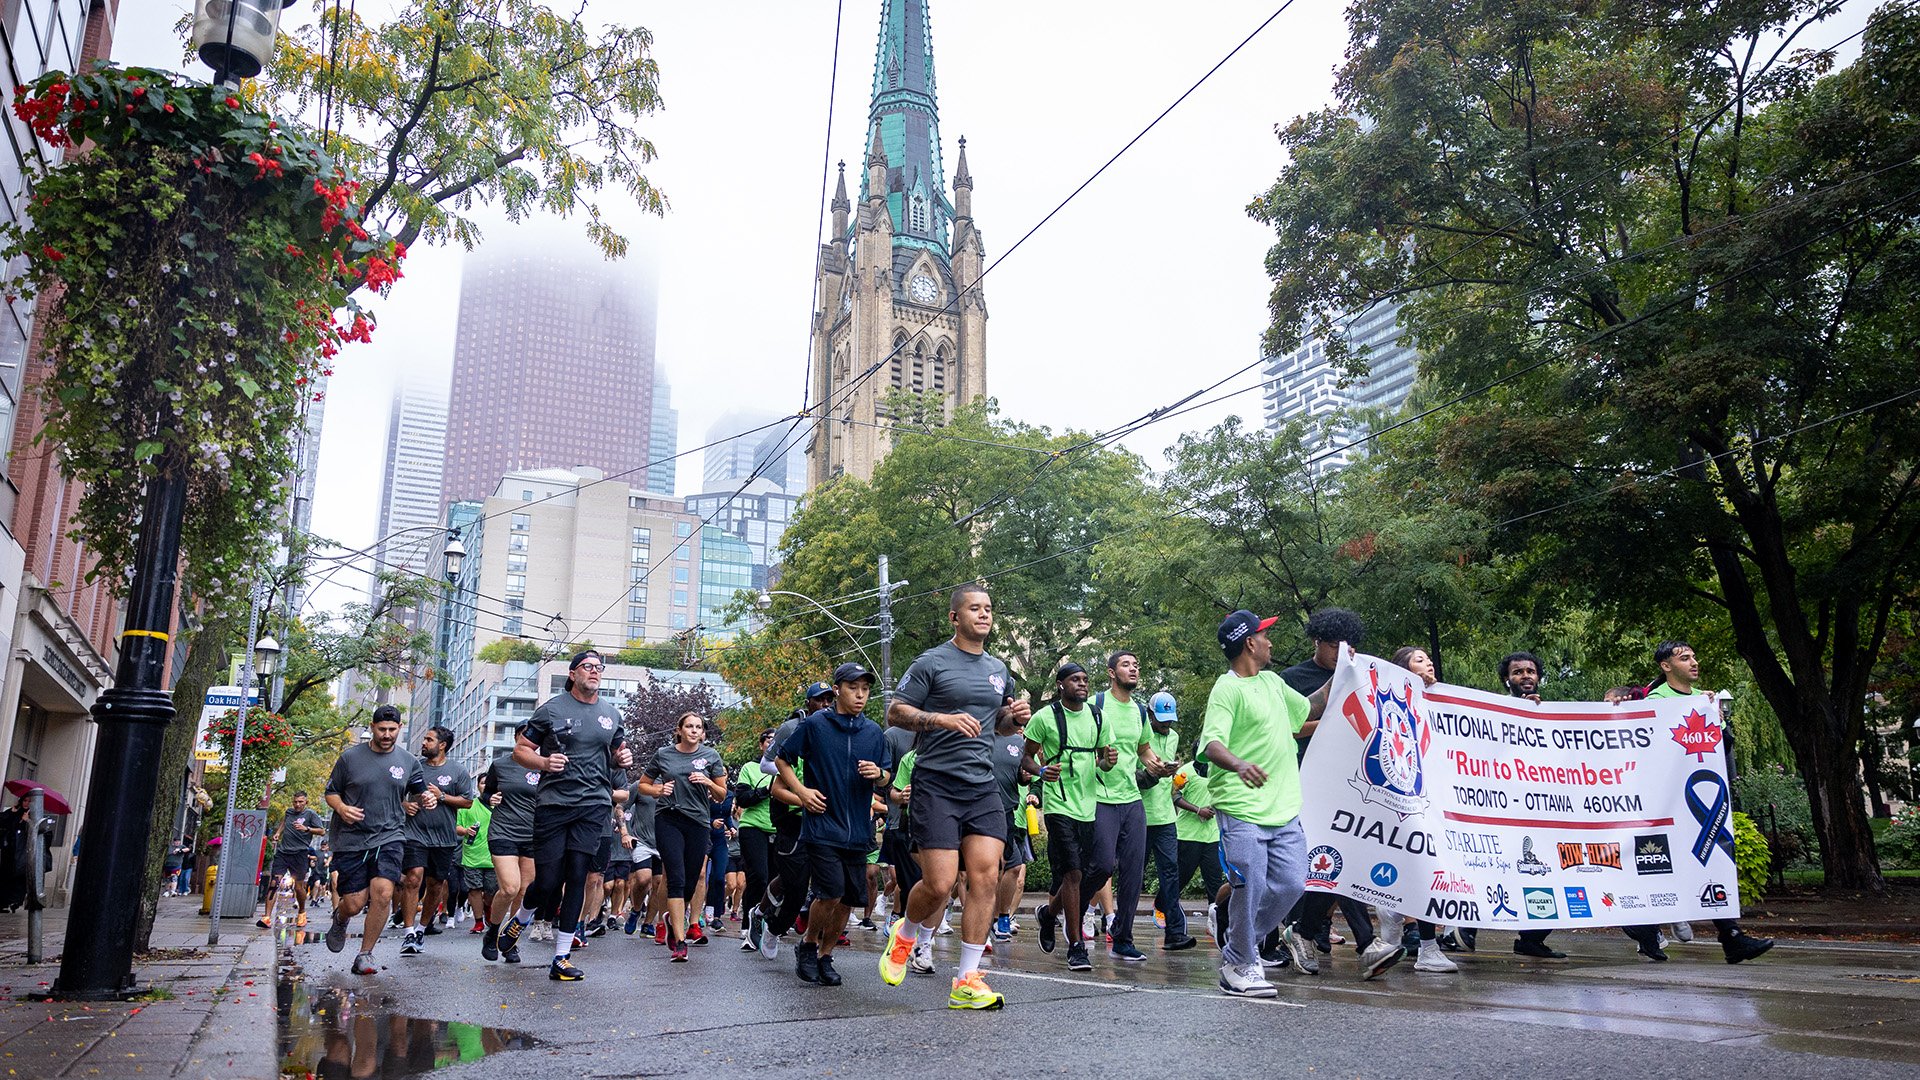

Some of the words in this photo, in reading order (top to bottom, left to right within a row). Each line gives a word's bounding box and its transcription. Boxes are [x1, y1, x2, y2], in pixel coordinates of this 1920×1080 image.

[209, 696, 225, 704] Oak
[226, 697, 241, 705] Hal
[1428, 709, 1498, 742] NATIONAL
[1501, 722, 1548, 748] PEACE
[1681, 731, 1702, 745] 460
[1703, 730, 1717, 744] K
[1382, 754, 1397, 781] SHALL
[1447, 749, 1491, 778] "Run
[1493, 758, 1512, 780] to
[1514, 758, 1636, 786] Remember"
[1372, 787, 1401, 802] NATIONAL
[1453, 785, 1508, 809] TORONTO
[1525, 792, 1574, 813] OTTAWA
[1583, 794, 1643, 813] 460KM
[1709, 825, 1718, 840] LIVE
[1715, 802, 1728, 826] FOREVER
[1445, 829, 1502, 854] STARLITE
[1307, 846, 1327, 861] OTOR
[1330, 849, 1341, 873] HOME
[1557, 842, 1584, 870] COW
[1585, 842, 1622, 870] HIDE
[1635, 854, 1670, 864] PRPA
[1351, 883, 1403, 903] MOTOROLA
[1430, 871, 1450, 893] Tim
[1450, 871, 1475, 895] Hortons
[1700, 884, 1727, 903] 46
[1352, 891, 1397, 908] SOLUTIONS
[1425, 897, 1481, 921] NORR
